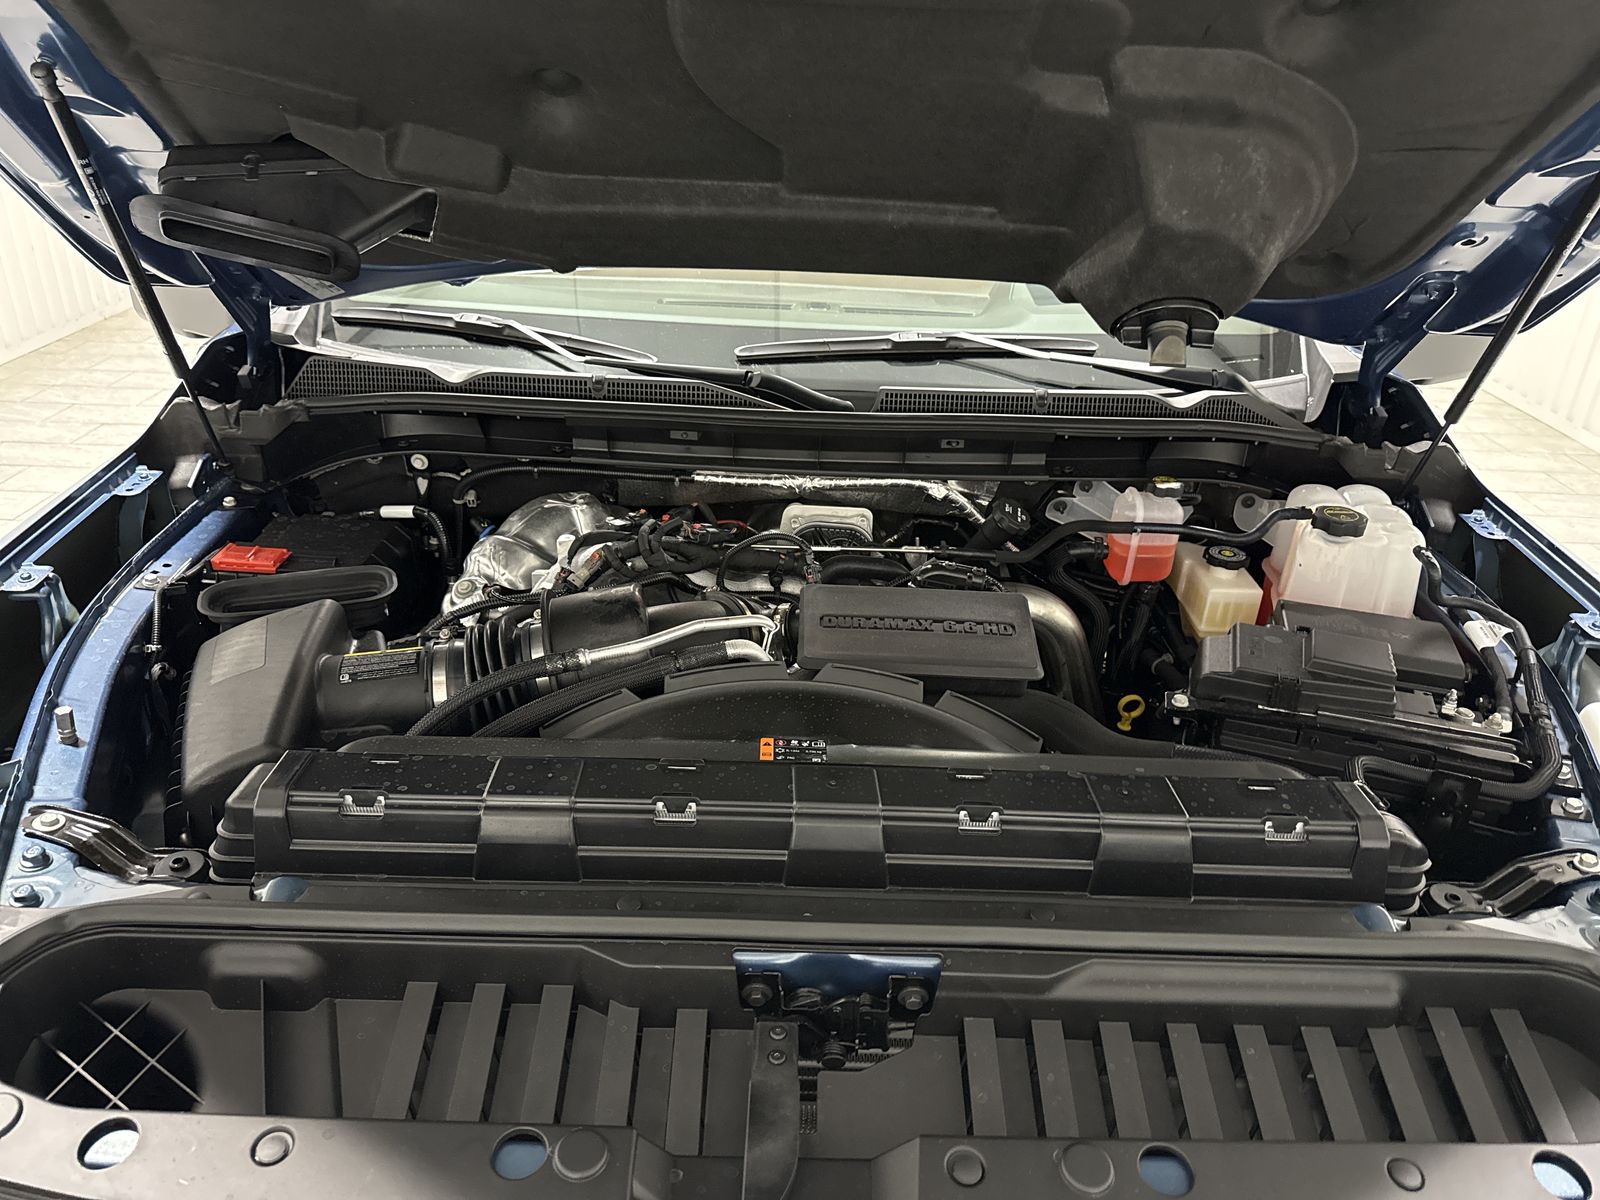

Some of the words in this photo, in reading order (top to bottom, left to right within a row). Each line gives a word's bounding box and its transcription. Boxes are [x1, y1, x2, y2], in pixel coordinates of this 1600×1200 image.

[822, 615, 934, 632] DURAMAX
[943, 619, 978, 635] 6.6
[983, 622, 1013, 637] HD
